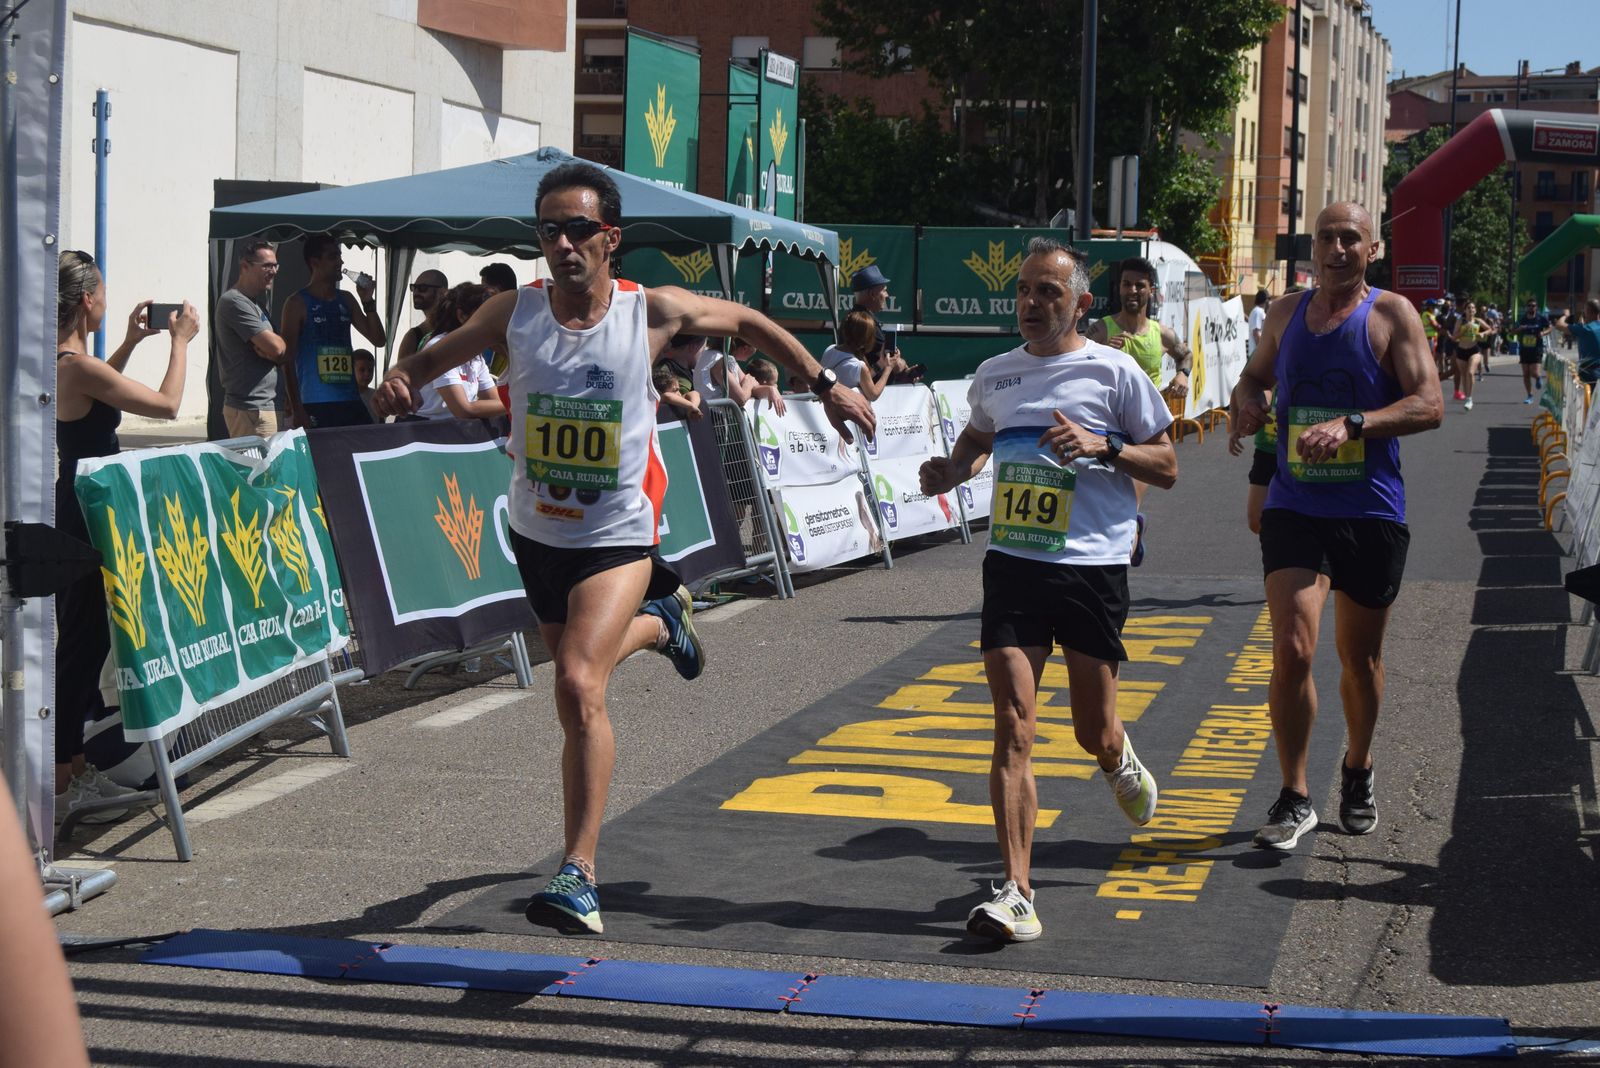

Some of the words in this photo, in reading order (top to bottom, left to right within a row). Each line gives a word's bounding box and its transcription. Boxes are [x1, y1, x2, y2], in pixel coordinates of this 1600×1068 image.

[1548, 137, 1594, 149] ZAMORA
[782, 292, 829, 309] CAJA
[837, 294, 901, 312] RUAL
[935, 298, 983, 315] CAJA
[323, 357, 348, 372] 128
[586, 381, 614, 389] DUERO
[995, 377, 1021, 391] BBVA
[554, 409, 577, 418] CAJA
[578, 411, 609, 420] RURAL
[1308, 410, 1350, 418] FUNDACI
[536, 422, 606, 461] 100
[550, 469, 574, 480] CAJA
[576, 472, 612, 484] RURAL
[1306, 468, 1328, 476] CAJA
[1330, 468, 1361, 477] RURAL
[1015, 475, 1033, 483] CAJA
[1034, 477, 1063, 487] RURAL
[540, 504, 578, 518] DHL
[1003, 488, 1058, 524] 149
[1008, 531, 1026, 541] CAJA
[1027, 533, 1060, 545] RURAL
[1170, 702, 1273, 780] INTEGRAL
[1095, 788, 1248, 903] REFORMA
